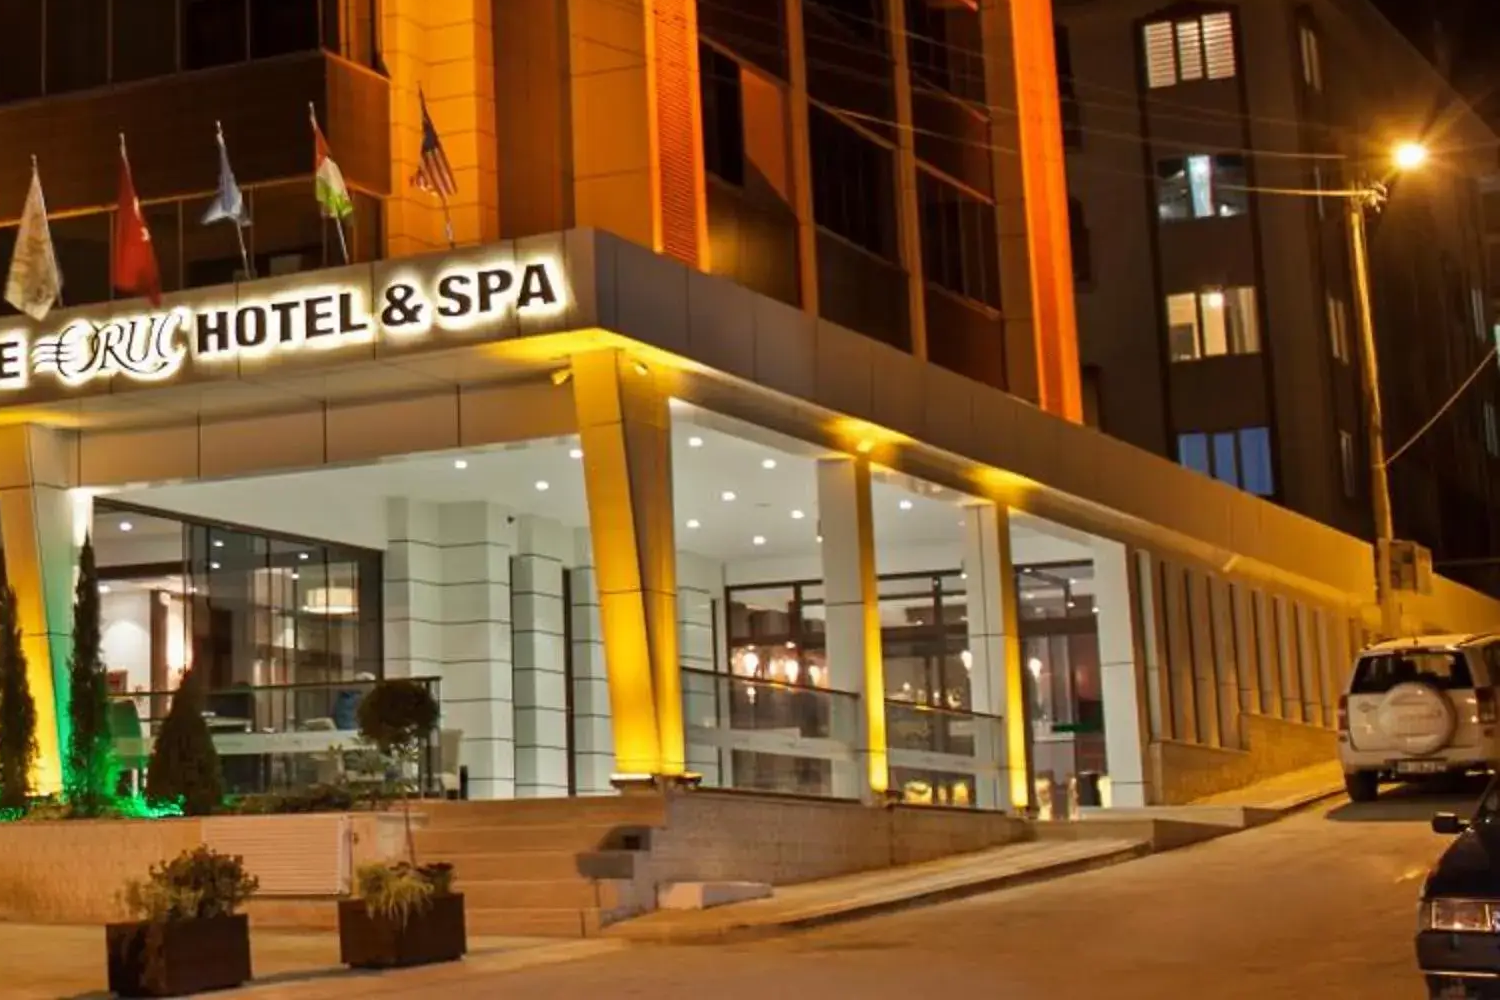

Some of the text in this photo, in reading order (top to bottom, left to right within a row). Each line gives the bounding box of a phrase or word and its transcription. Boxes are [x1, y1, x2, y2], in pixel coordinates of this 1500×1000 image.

[195, 291, 368, 353] HOTEL
[380, 282, 425, 328] &
[437, 263, 557, 318] SPA
